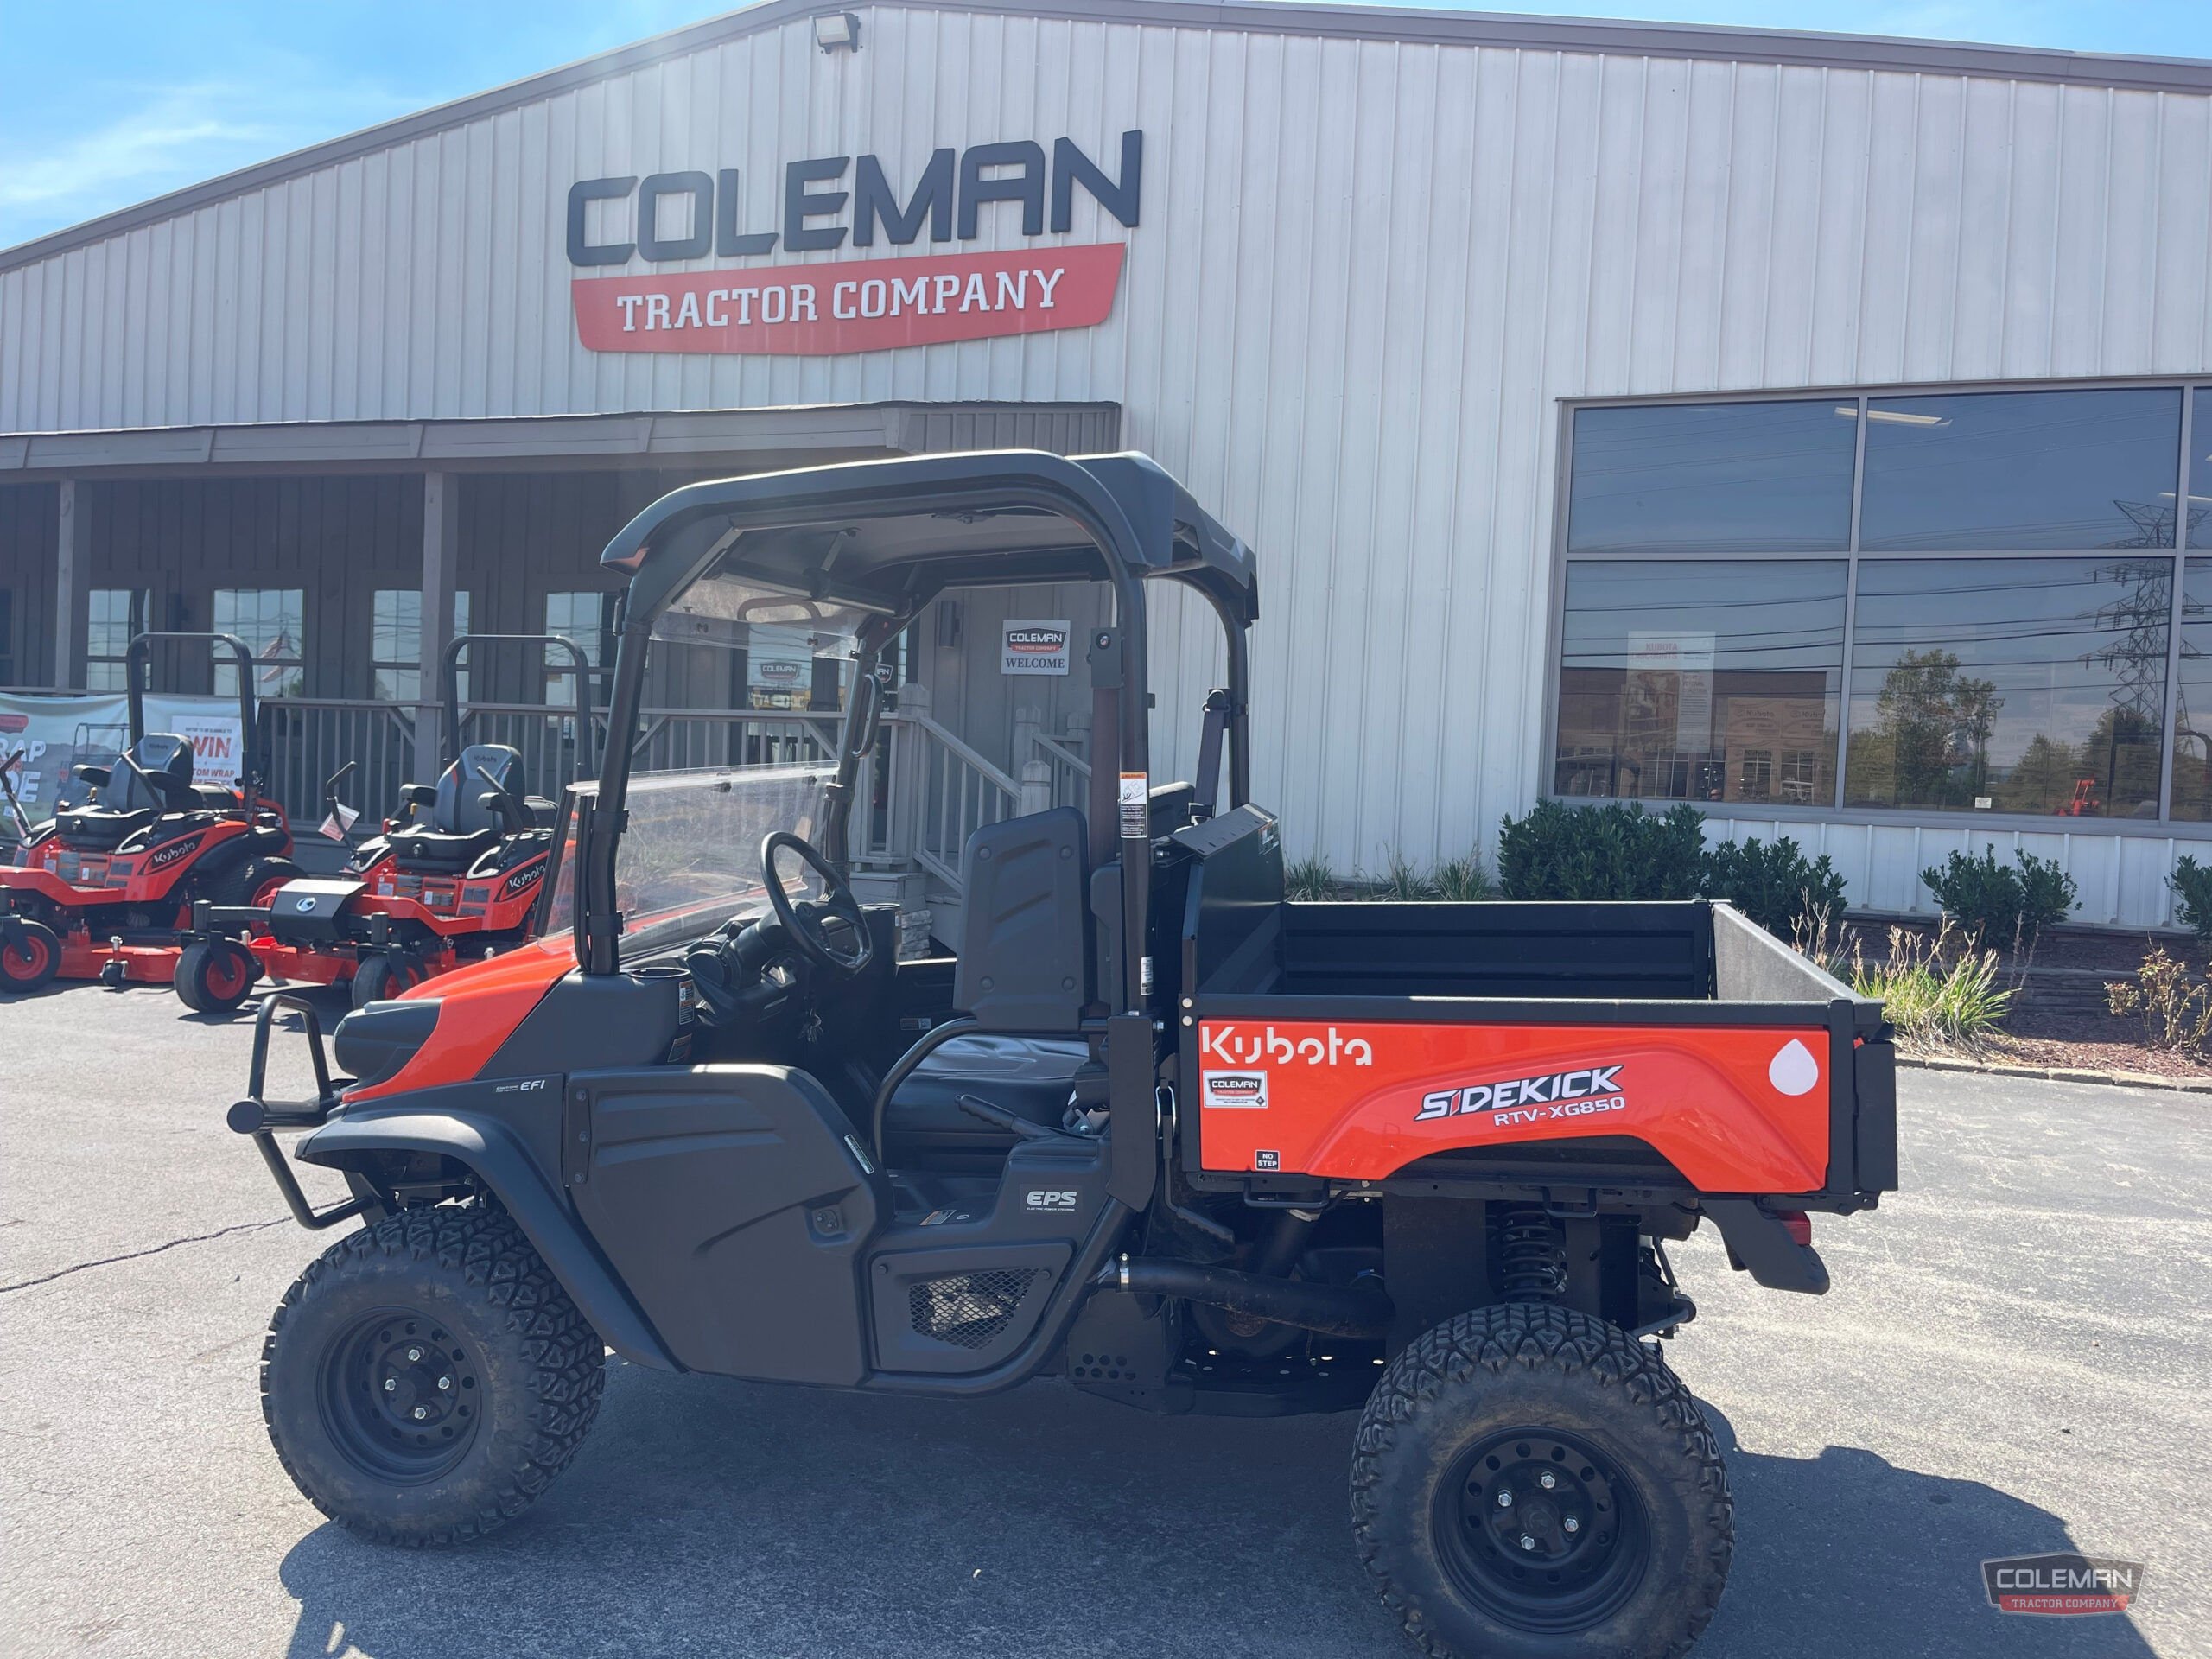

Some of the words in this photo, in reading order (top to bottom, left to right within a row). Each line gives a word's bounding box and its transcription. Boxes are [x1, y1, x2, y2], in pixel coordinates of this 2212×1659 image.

[567, 130, 1142, 267] COLEMAN
[616, 283, 818, 332] TRACTOR
[833, 268, 1065, 321] COMPANY
[1009, 633, 1062, 642] COLEMAN
[762, 664, 797, 673] COLEMAN
[1006, 658, 1065, 669] WELCOME
[188, 735, 232, 759] WIN
[211, 769, 235, 778] WRAP
[154, 842, 196, 864] Kubota
[509, 864, 546, 888] Kubota
[1202, 1026, 1372, 1066] Kubota
[520, 1080, 545, 1091] EFI
[1211, 1080, 1258, 1089] COLEMAN
[1414, 1065, 1625, 1122] SIDEKICK
[1494, 1096, 1626, 1127] RTV-XG850
[1027, 1191, 1077, 1205] EPS
